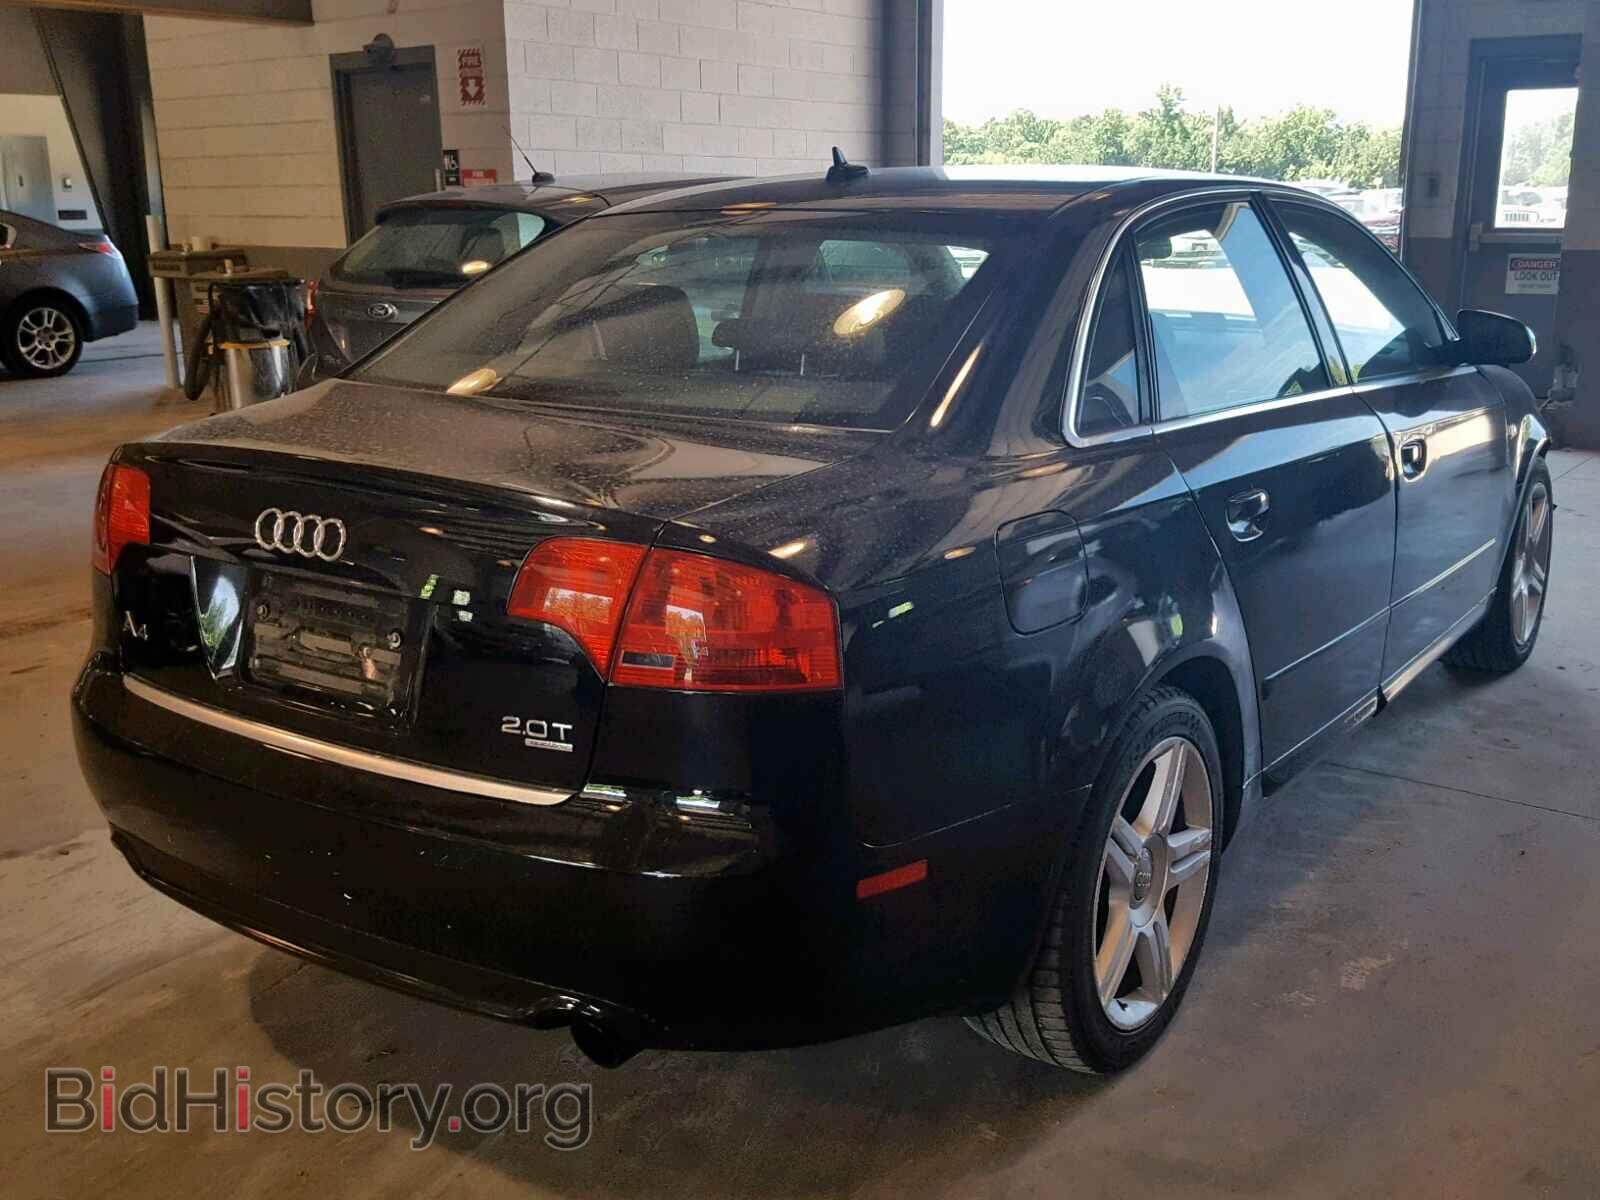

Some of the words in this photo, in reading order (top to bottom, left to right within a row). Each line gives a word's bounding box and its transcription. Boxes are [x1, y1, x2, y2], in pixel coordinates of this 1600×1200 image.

[1514, 271, 1538, 281] LOOK
[1540, 271, 1560, 281] OUT
[122, 610, 149, 641] A4
[501, 715, 573, 741] 2.0T
